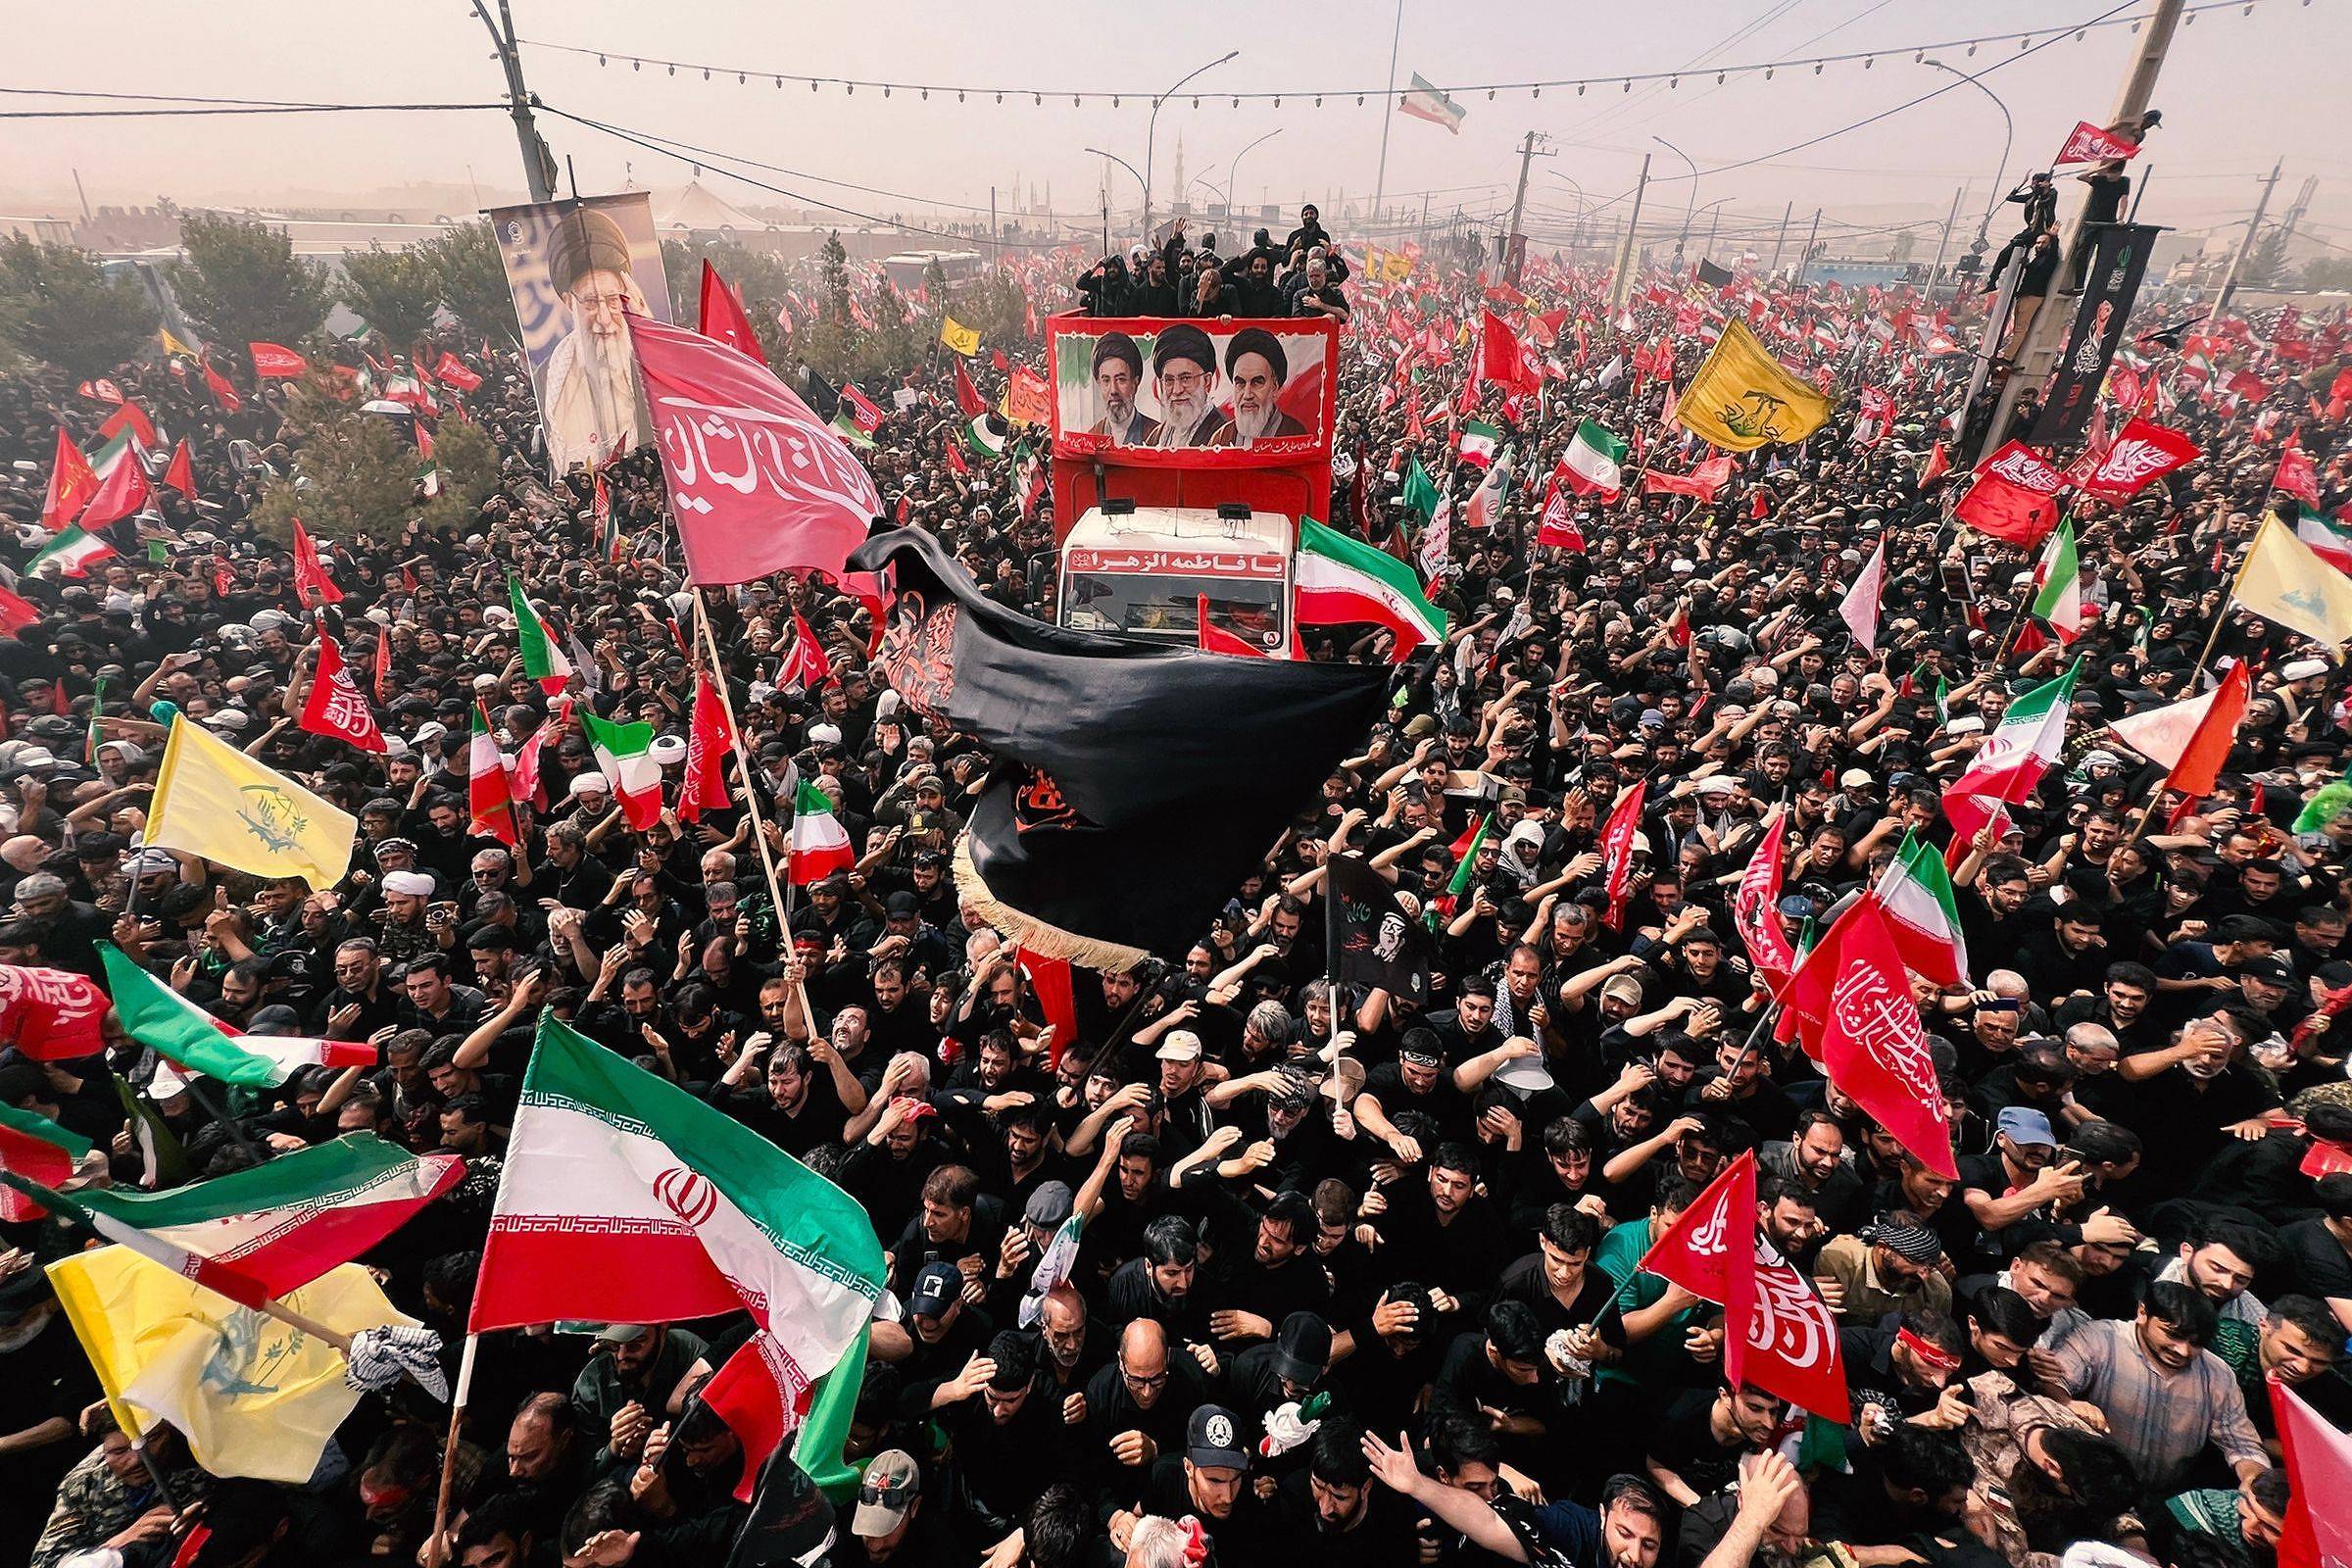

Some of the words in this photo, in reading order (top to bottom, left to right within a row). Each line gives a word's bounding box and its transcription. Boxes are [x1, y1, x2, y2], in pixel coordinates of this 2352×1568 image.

[1091, 552, 1166, 572] الزهرا
[1170, 554, 1247, 571] فاطمه
[1250, 557, 1283, 576] یا
